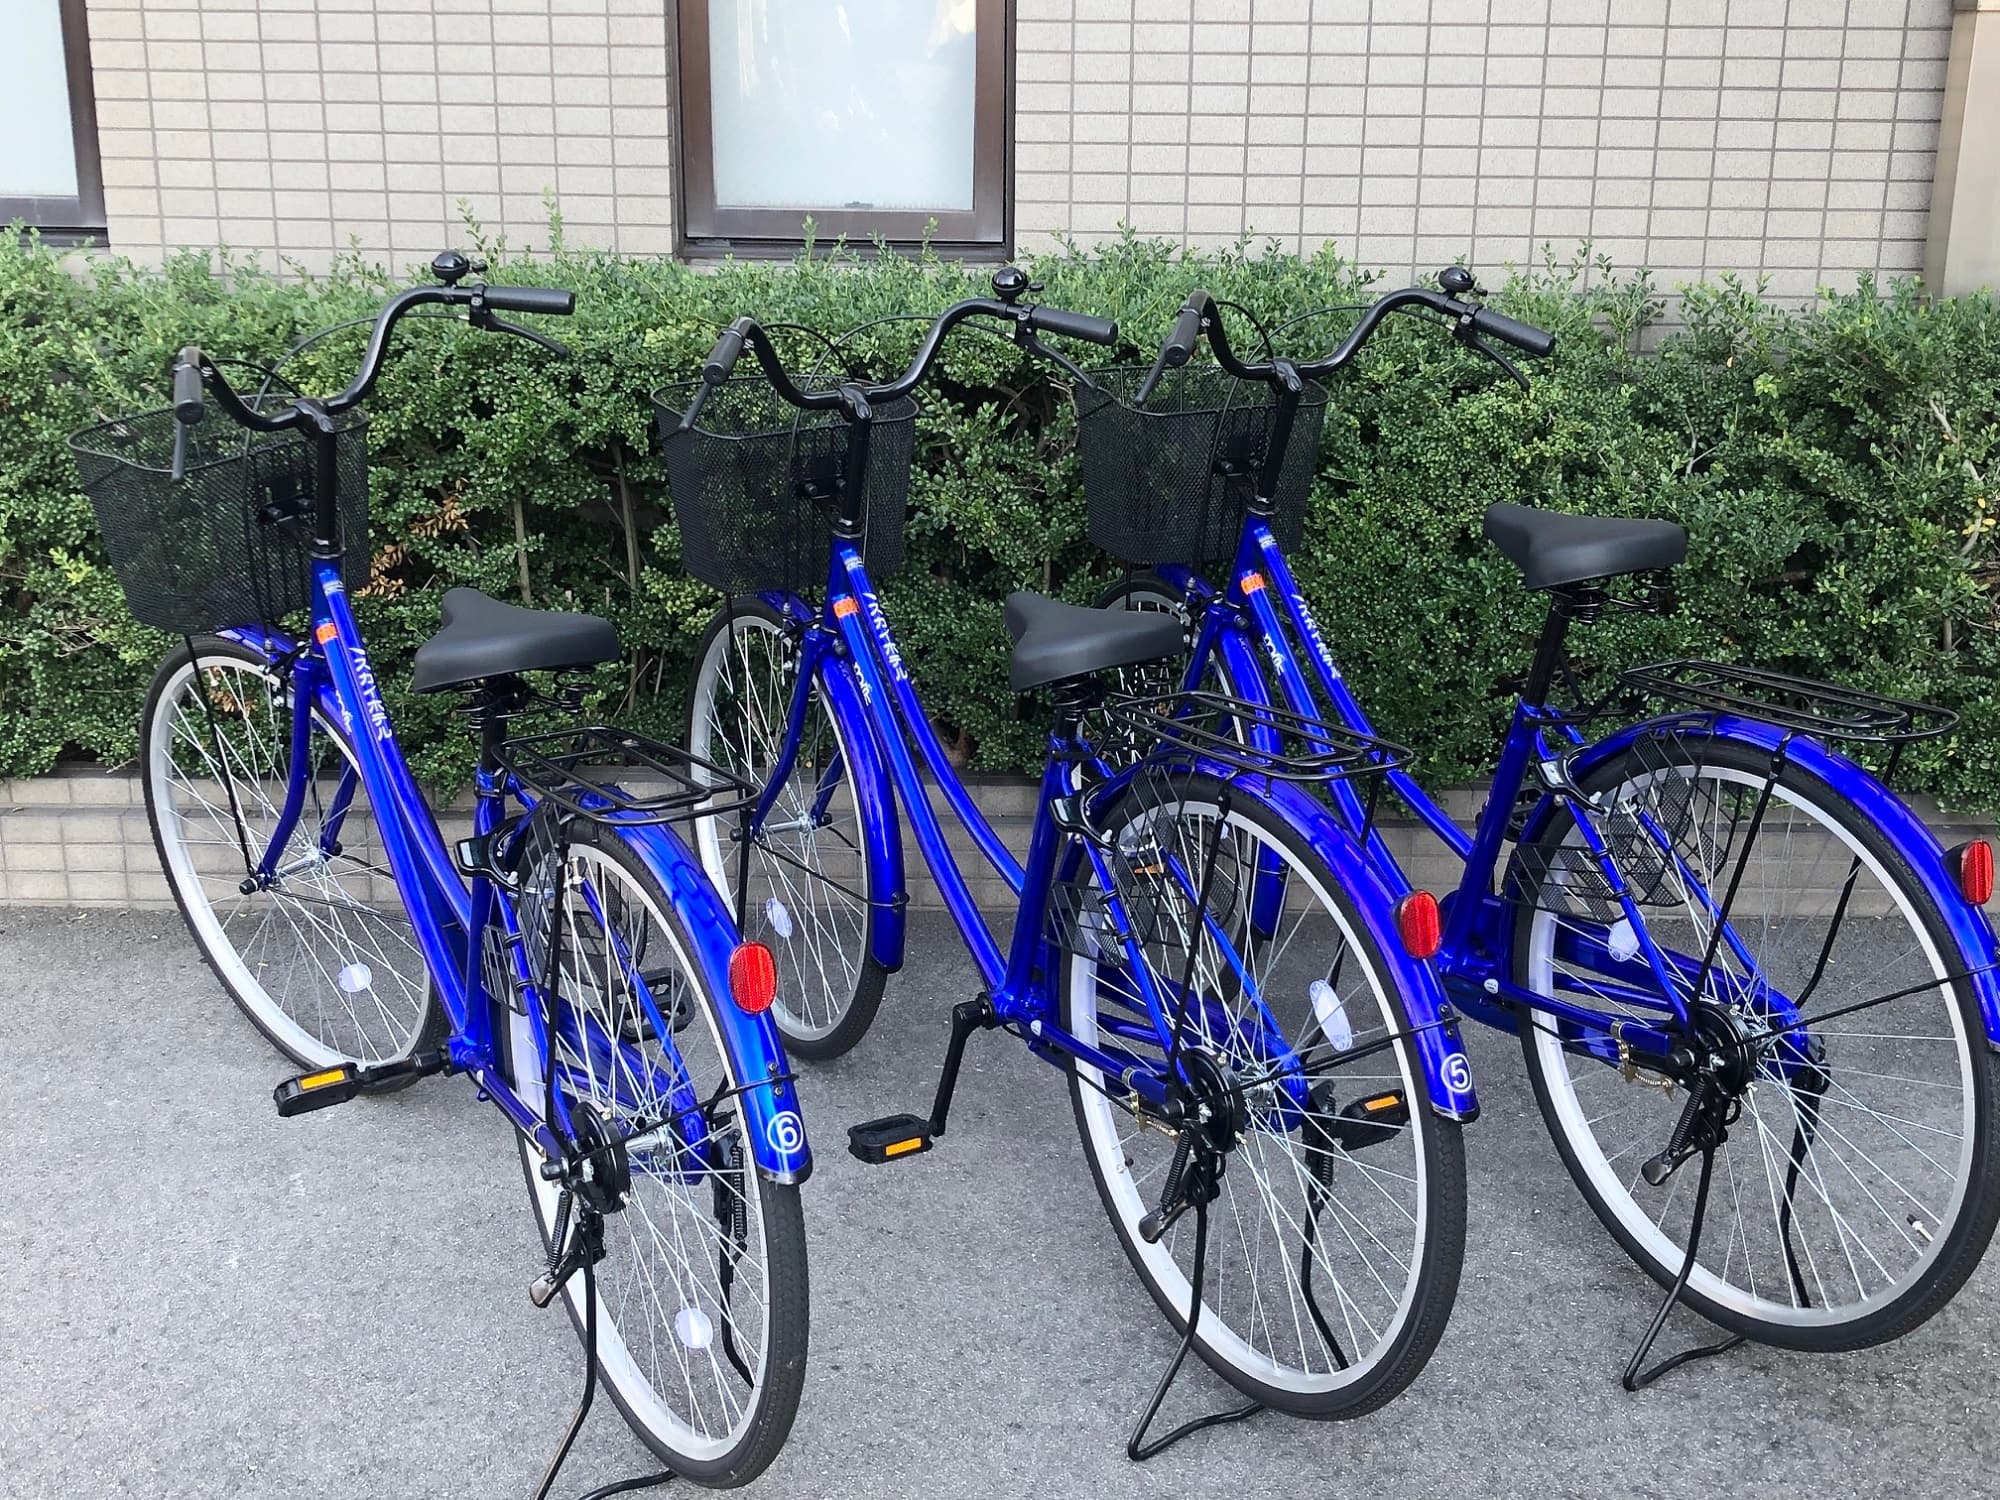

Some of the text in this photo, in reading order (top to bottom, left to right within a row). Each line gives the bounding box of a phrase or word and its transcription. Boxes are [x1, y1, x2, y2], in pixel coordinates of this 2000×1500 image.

[868, 603, 908, 681] スカイホテル
[354, 657, 393, 742] スカイホテル
